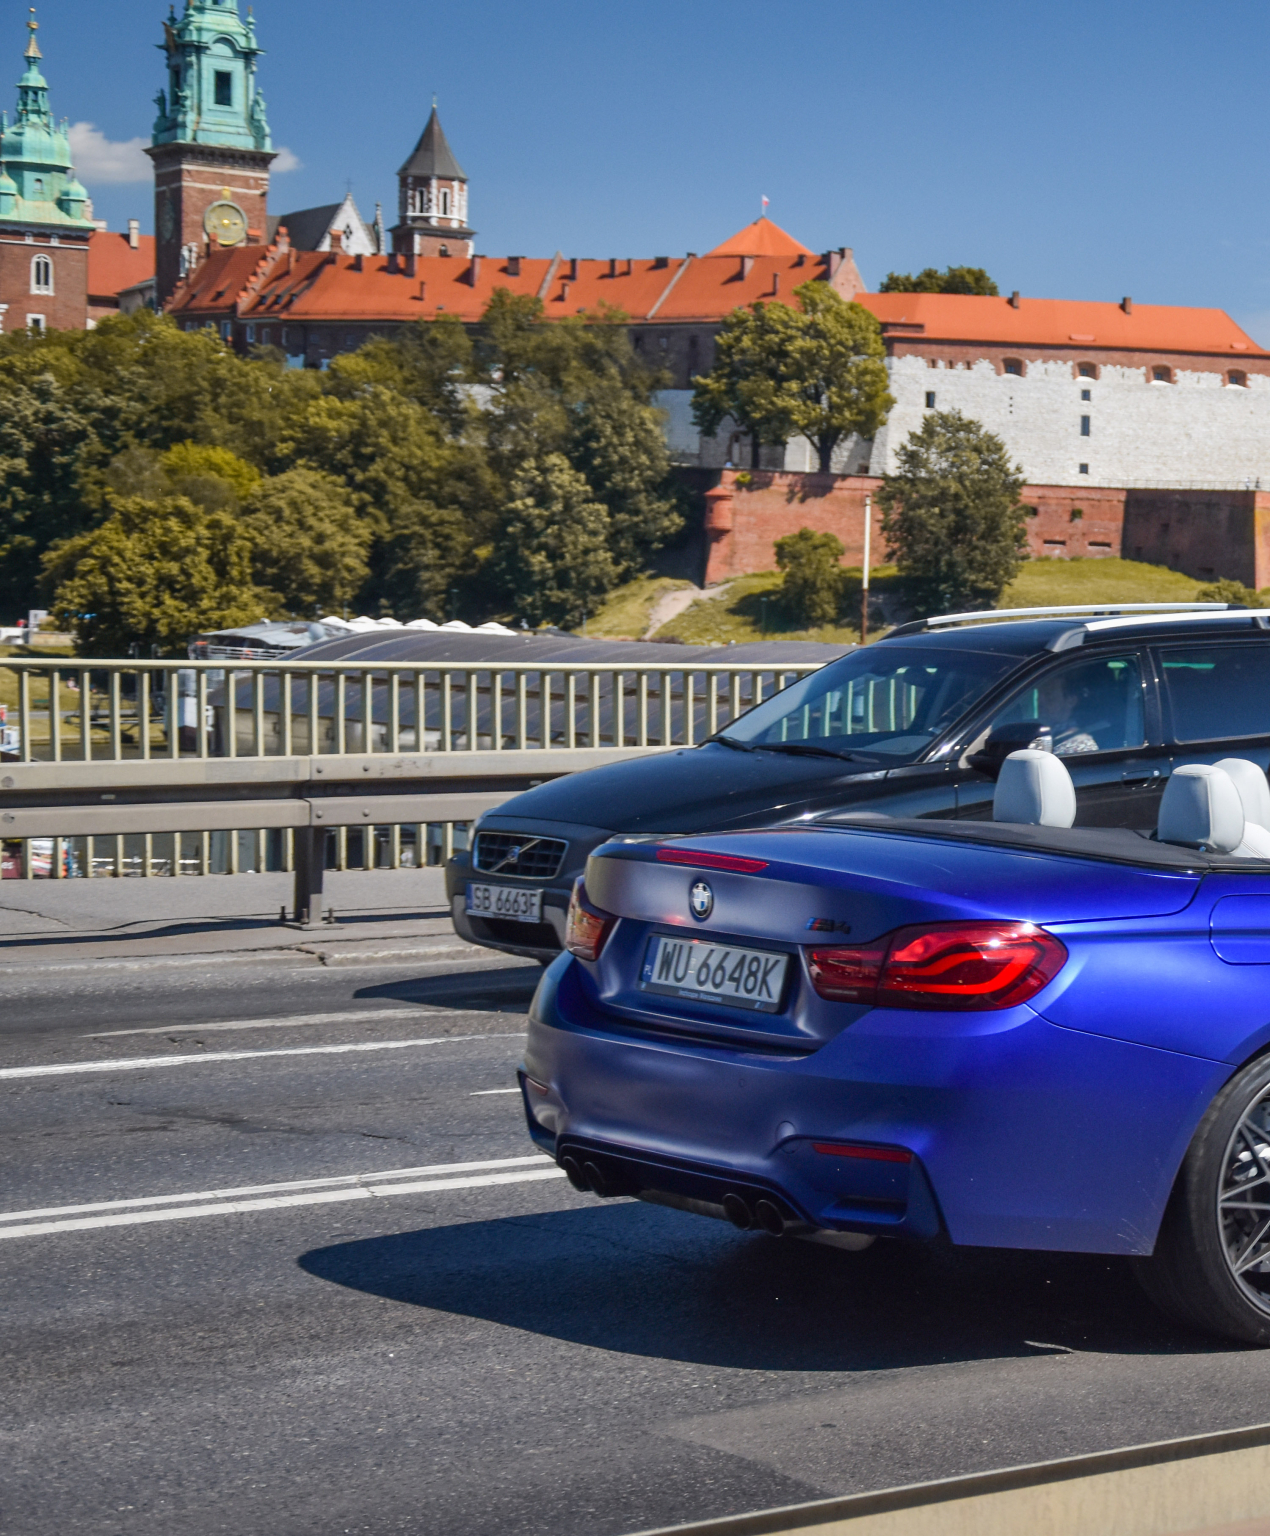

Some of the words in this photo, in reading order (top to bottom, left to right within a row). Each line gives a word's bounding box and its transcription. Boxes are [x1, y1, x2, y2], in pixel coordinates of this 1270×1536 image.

[474, 886, 491, 910] SB
[496, 889, 538, 915] 6663F
[658, 942, 693, 983] WU
[696, 948, 781, 999] 6648K
